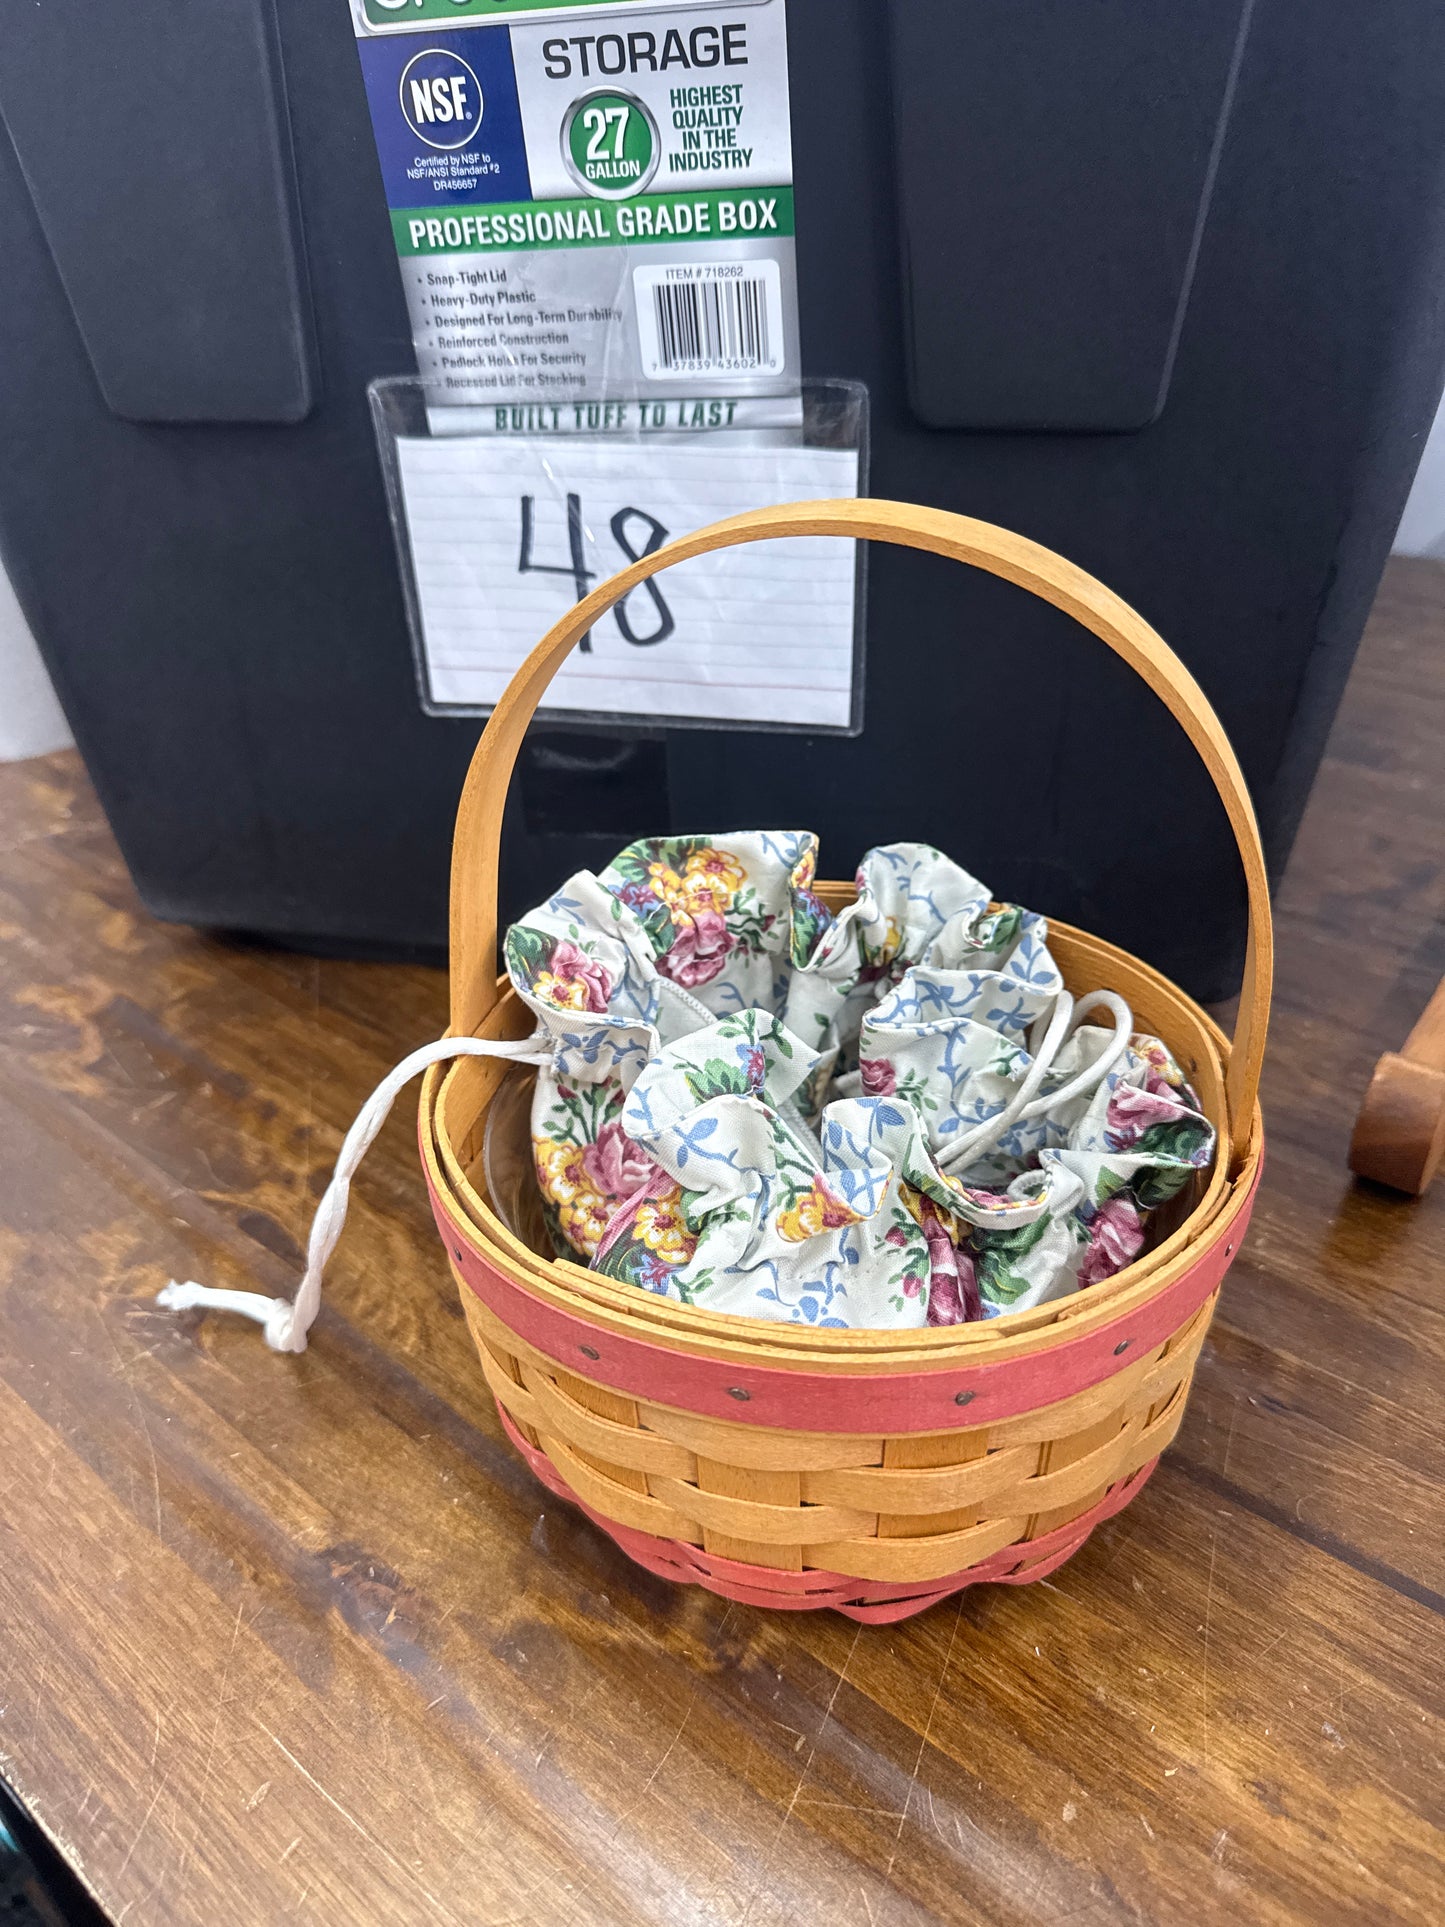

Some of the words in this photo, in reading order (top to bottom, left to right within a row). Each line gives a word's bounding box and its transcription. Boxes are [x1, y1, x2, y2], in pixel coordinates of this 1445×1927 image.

[542, 23, 749, 80] STORAGE
[410, 76, 467, 124] NSF
[669, 84, 743, 108] HIGHEST
[672, 106, 744, 130] QUALITY
[583, 107, 630, 161] 27
[682, 130, 703, 150] IN
[704, 128, 737, 148] THE
[414, 155, 449, 168] Certified
[450, 155, 460, 168] by
[461, 153, 480, 165] NSF
[482, 153, 491, 164] to
[585, 160, 641, 180] GALLON
[669, 148, 753, 173] INDUSTRY
[407, 167, 449, 180] NSF/ANSI
[450, 164, 489, 177] Standard
[433, 178, 478, 191] DR456657
[408, 208, 611, 249] PROFESSIONAL
[616, 201, 711, 237] GRADE
[718, 198, 778, 231] BOX
[427, 271, 489, 288] Snap-Tight
[490, 269, 507, 283] Lid
[666, 268, 693, 280] ITEM
[695, 267, 702, 279] #
[704, 266, 744, 279] 718262
[431, 292, 495, 309] Heavy-Duty
[498, 290, 537, 305] Plastic
[434, 314, 486, 330] Designed
[487, 313, 505, 326] For
[507, 310, 566, 327] Long-Term
[438, 333, 498, 349] Reinforced
[499, 331, 569, 346] Construction
[442, 355, 486, 369] Padlock
[521, 354, 538, 367] For
[540, 351, 586, 367] Security
[651, 363, 658, 372] 7
[673, 360, 711, 372] 37839
[717, 358, 756, 371] 43602
[769, 359, 777, 368] 0
[495, 404, 562, 432] BUILT
[573, 402, 627, 430] TUFF
[639, 401, 666, 428] TO
[678, 400, 738, 427] LAST
[518, 493, 676, 654] 48
